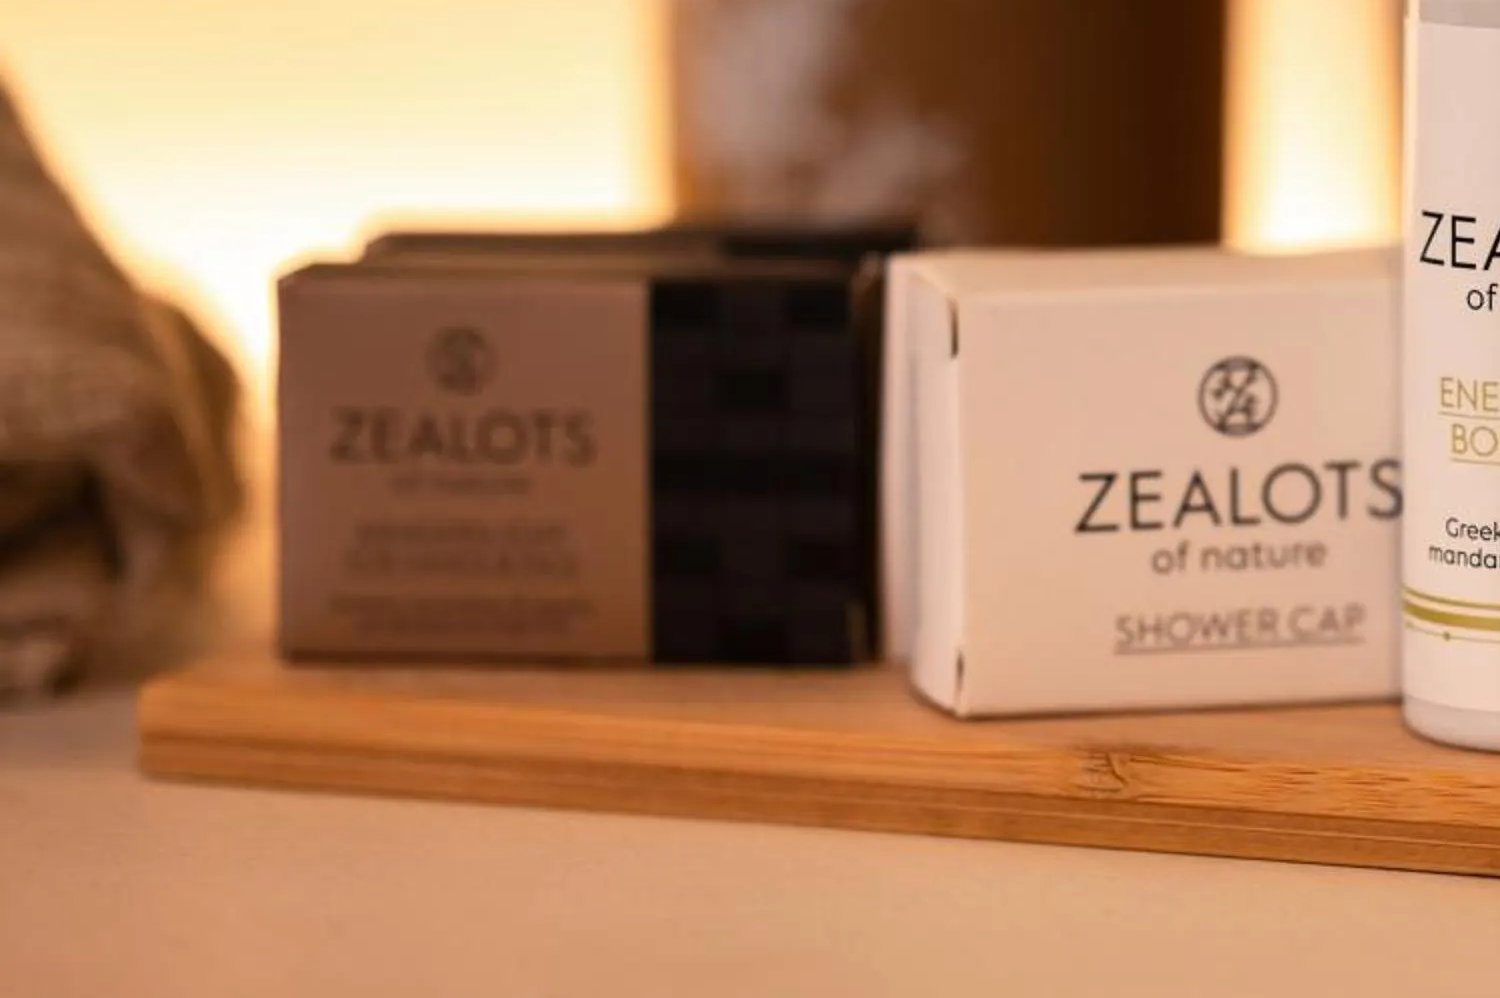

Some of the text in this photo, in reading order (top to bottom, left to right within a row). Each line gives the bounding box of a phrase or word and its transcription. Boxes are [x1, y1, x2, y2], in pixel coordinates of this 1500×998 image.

[1466, 284, 1498, 311] of
[330, 407, 598, 467] ZEALOTS
[1073, 459, 1404, 534] ZEALOTS
[1151, 539, 1327, 574] of nature
[1115, 602, 1366, 647] SHOWER CAP
